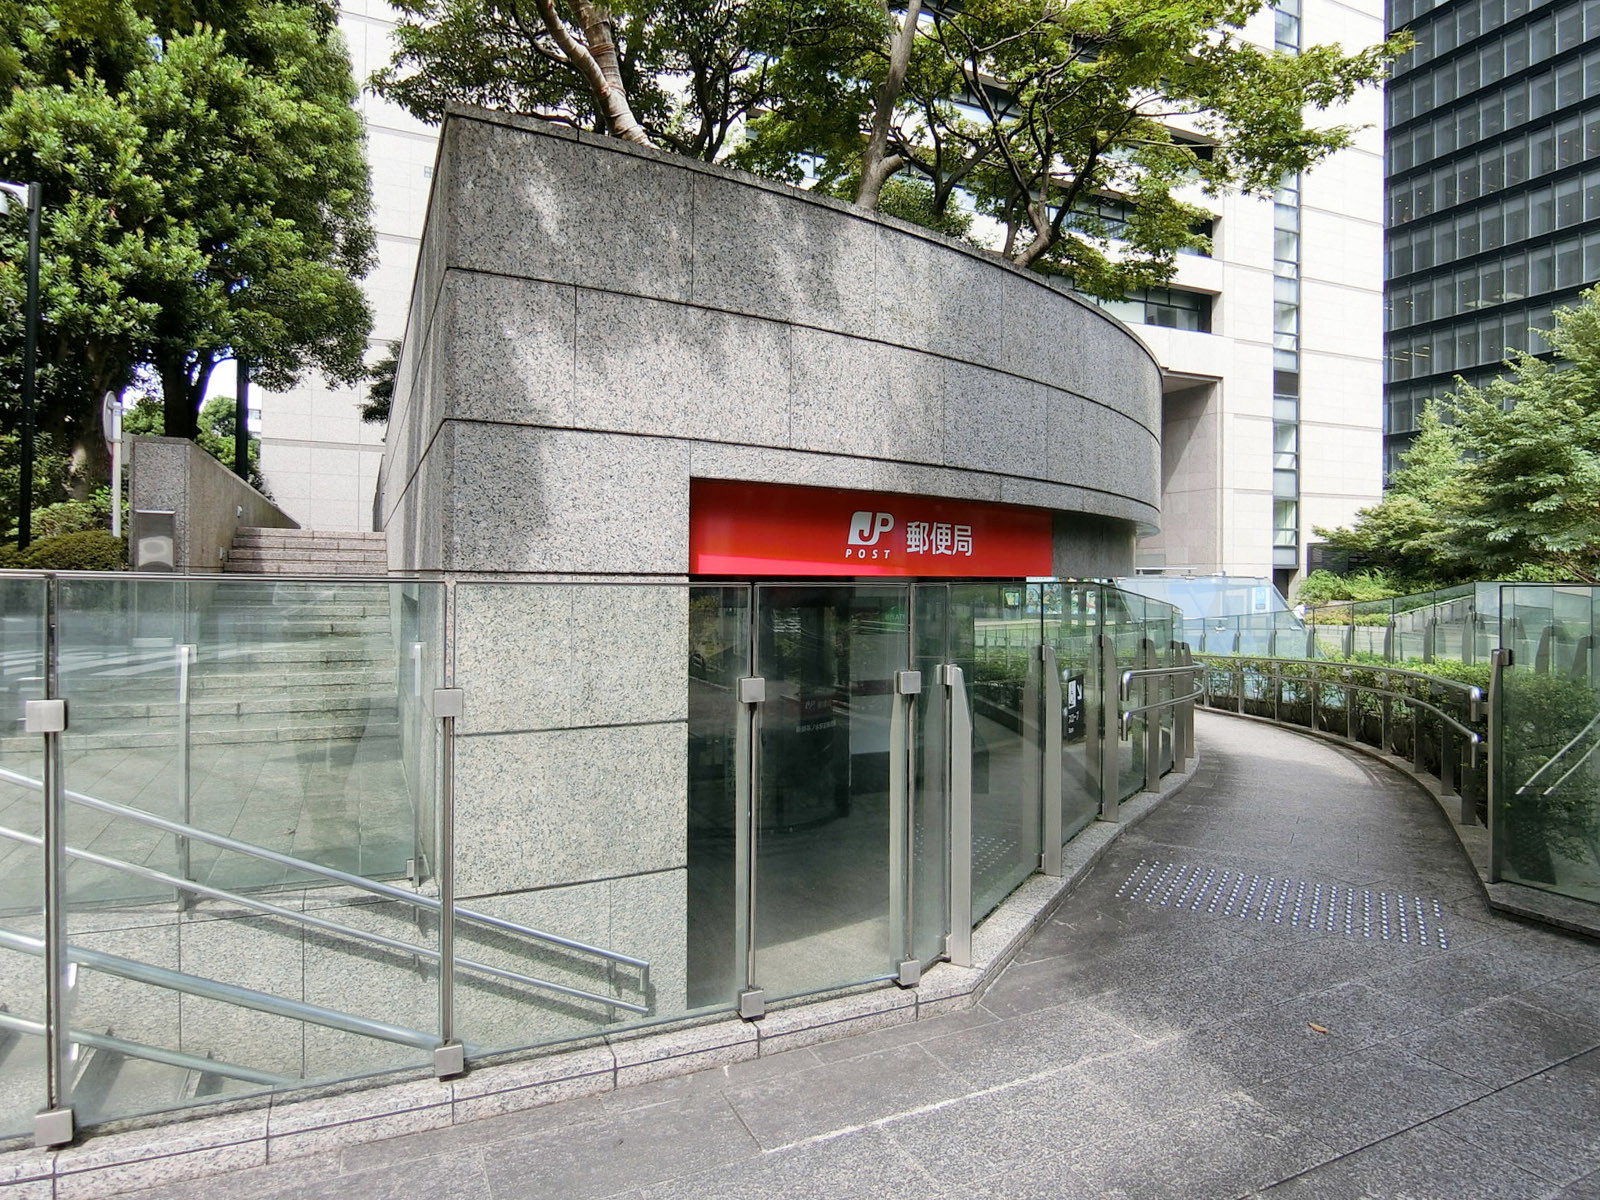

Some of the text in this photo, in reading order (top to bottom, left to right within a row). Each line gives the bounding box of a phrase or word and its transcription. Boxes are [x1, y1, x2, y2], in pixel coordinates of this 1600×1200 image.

[906, 520, 973, 556] 郵便局
[845, 548, 891, 560] POST
